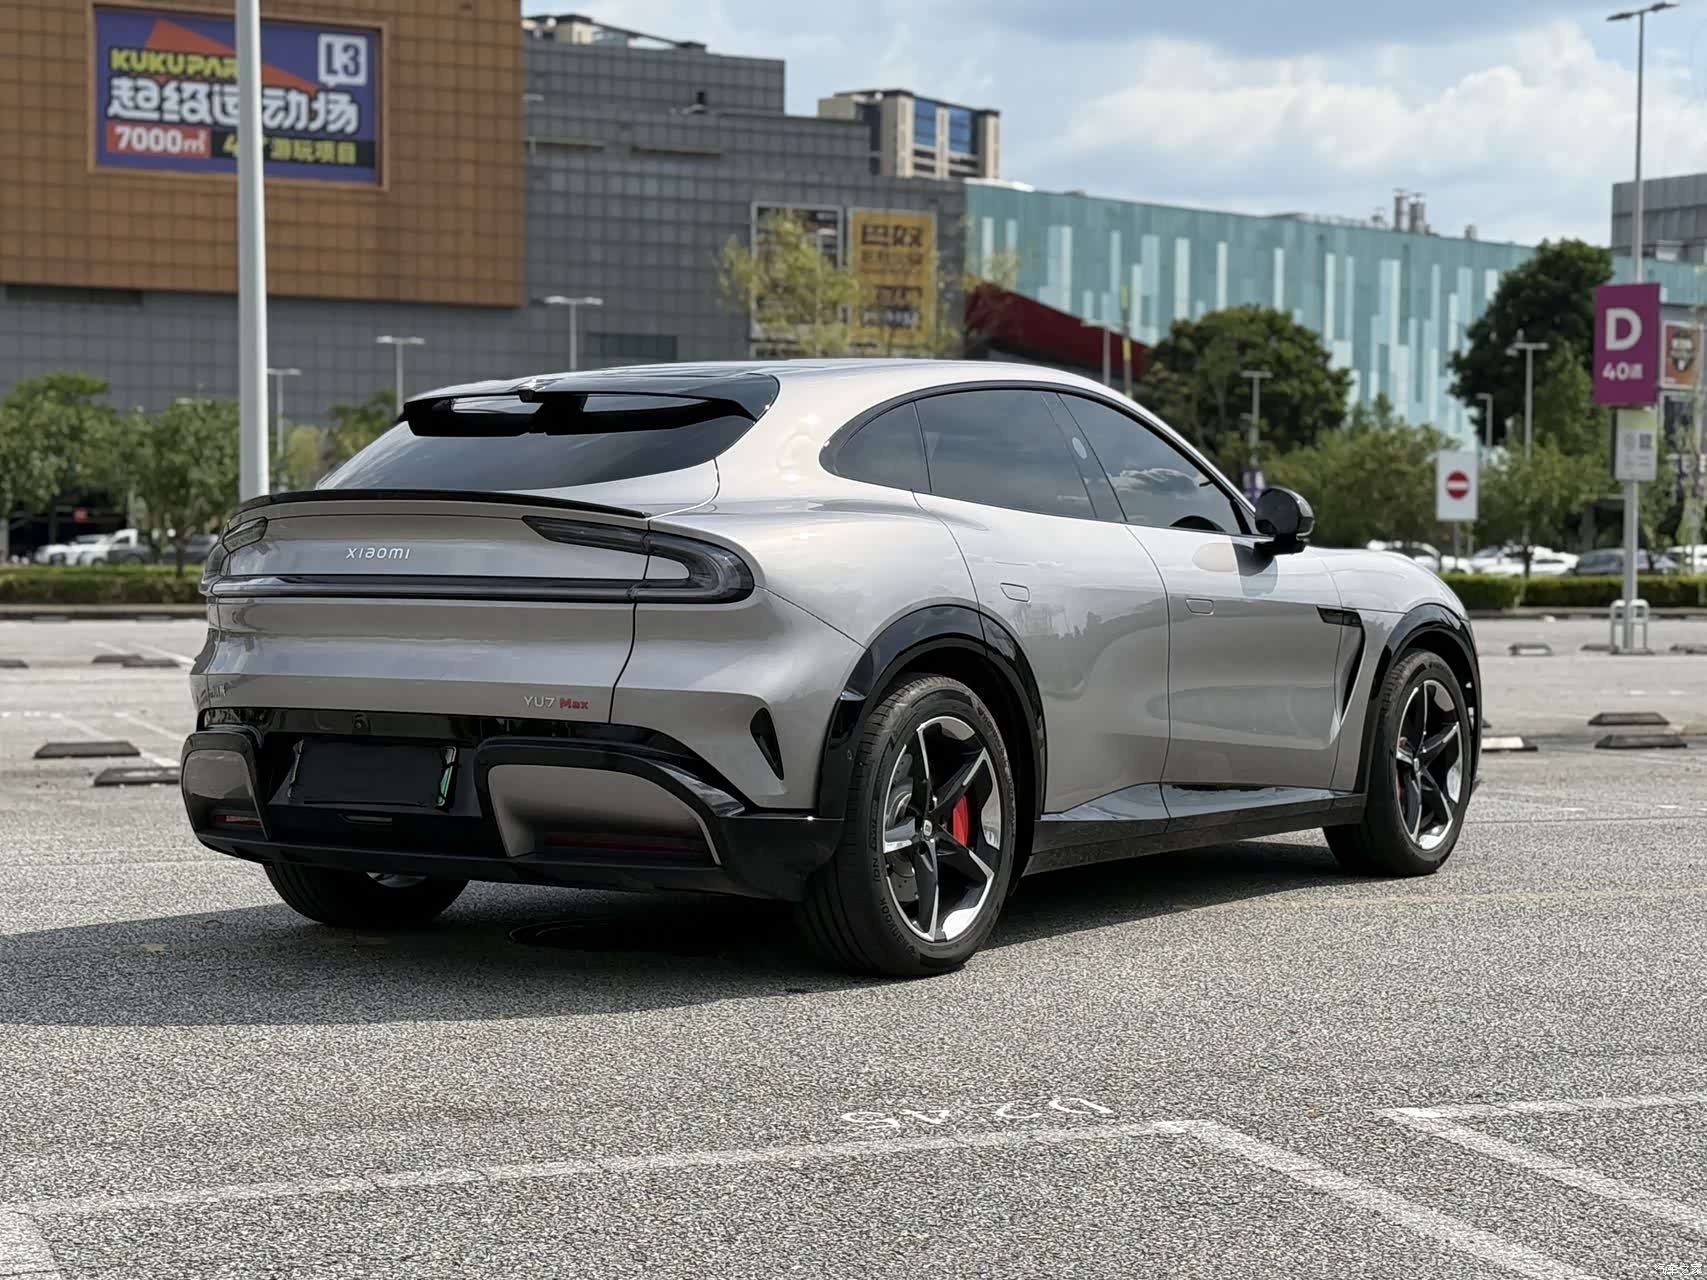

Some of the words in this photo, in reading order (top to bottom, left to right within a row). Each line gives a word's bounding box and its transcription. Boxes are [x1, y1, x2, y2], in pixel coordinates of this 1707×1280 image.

[111, 48, 238, 80] KUKUPAR
[324, 42, 361, 77] L3
[1605, 307, 1642, 350] D
[523, 696, 555, 709] YU7
[559, 698, 589, 710] Max
